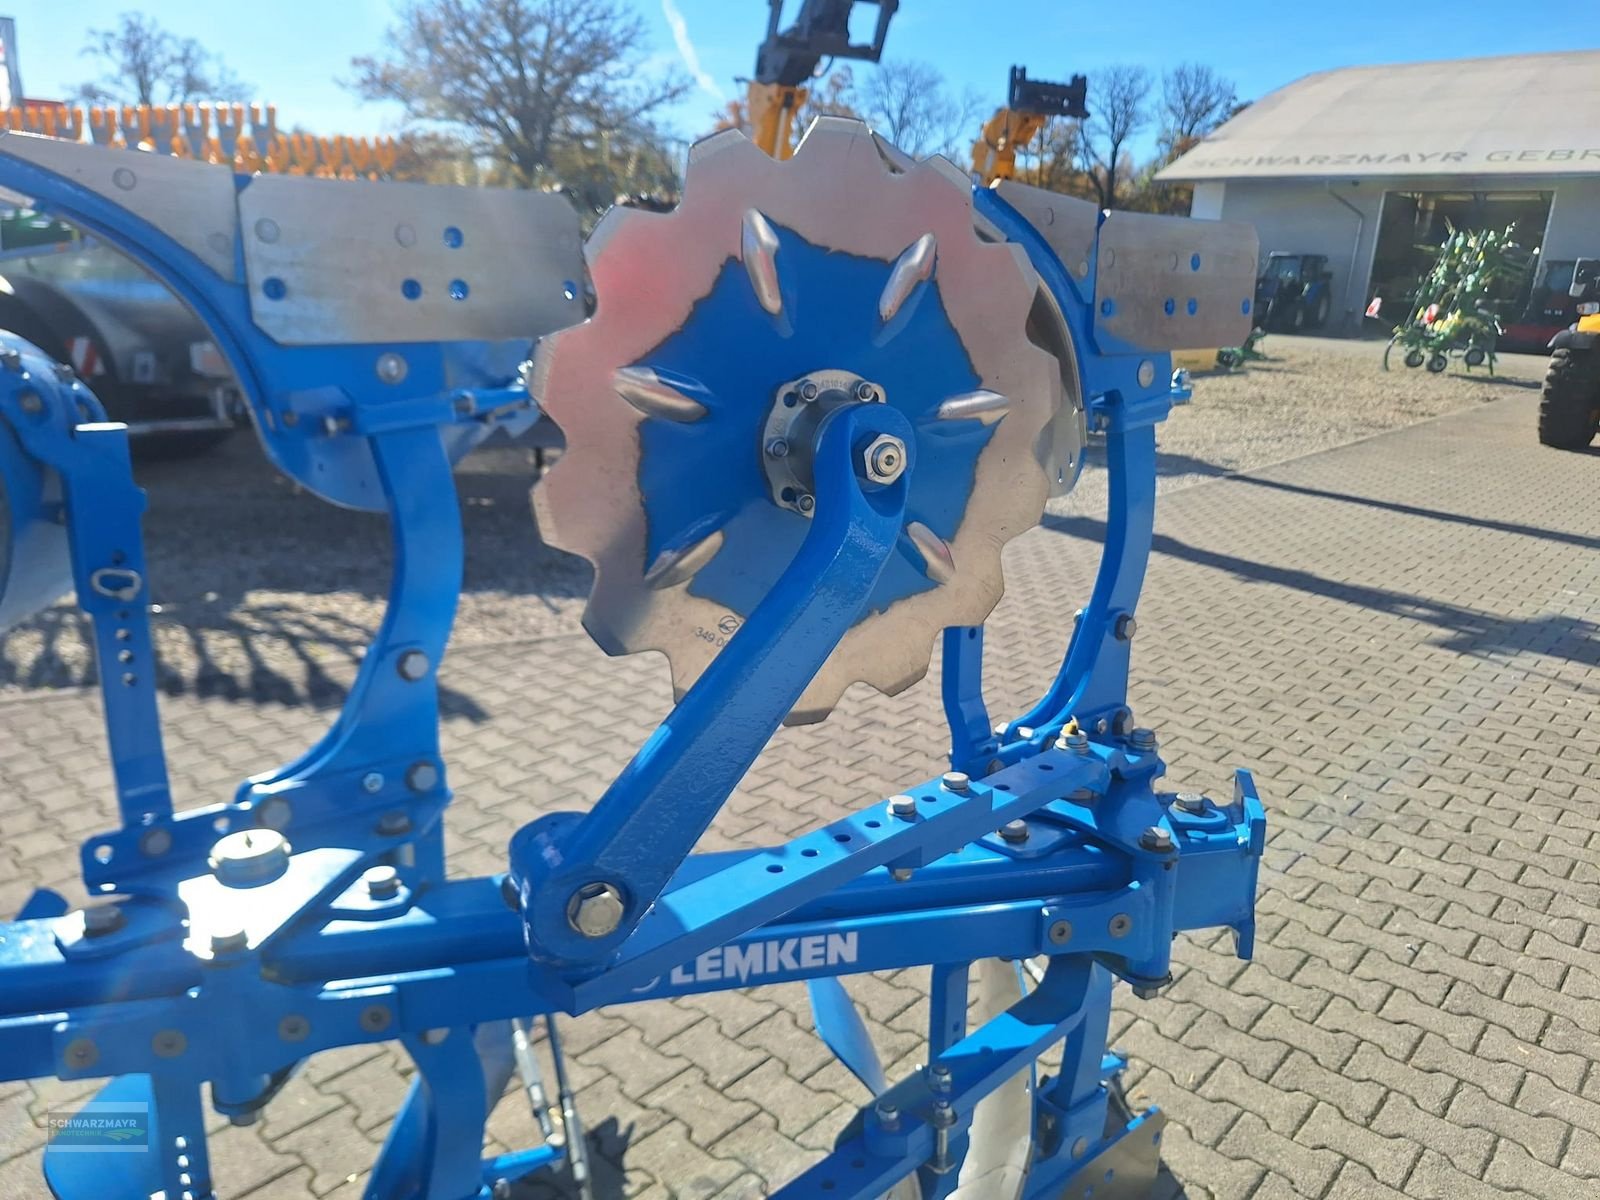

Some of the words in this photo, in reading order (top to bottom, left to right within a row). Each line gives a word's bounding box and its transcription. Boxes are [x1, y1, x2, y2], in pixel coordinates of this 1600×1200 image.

[1190, 151, 1468, 169] SCHWARZMAYR
[695, 626, 715, 643] 349
[670, 931, 858, 984] LEMKEN
